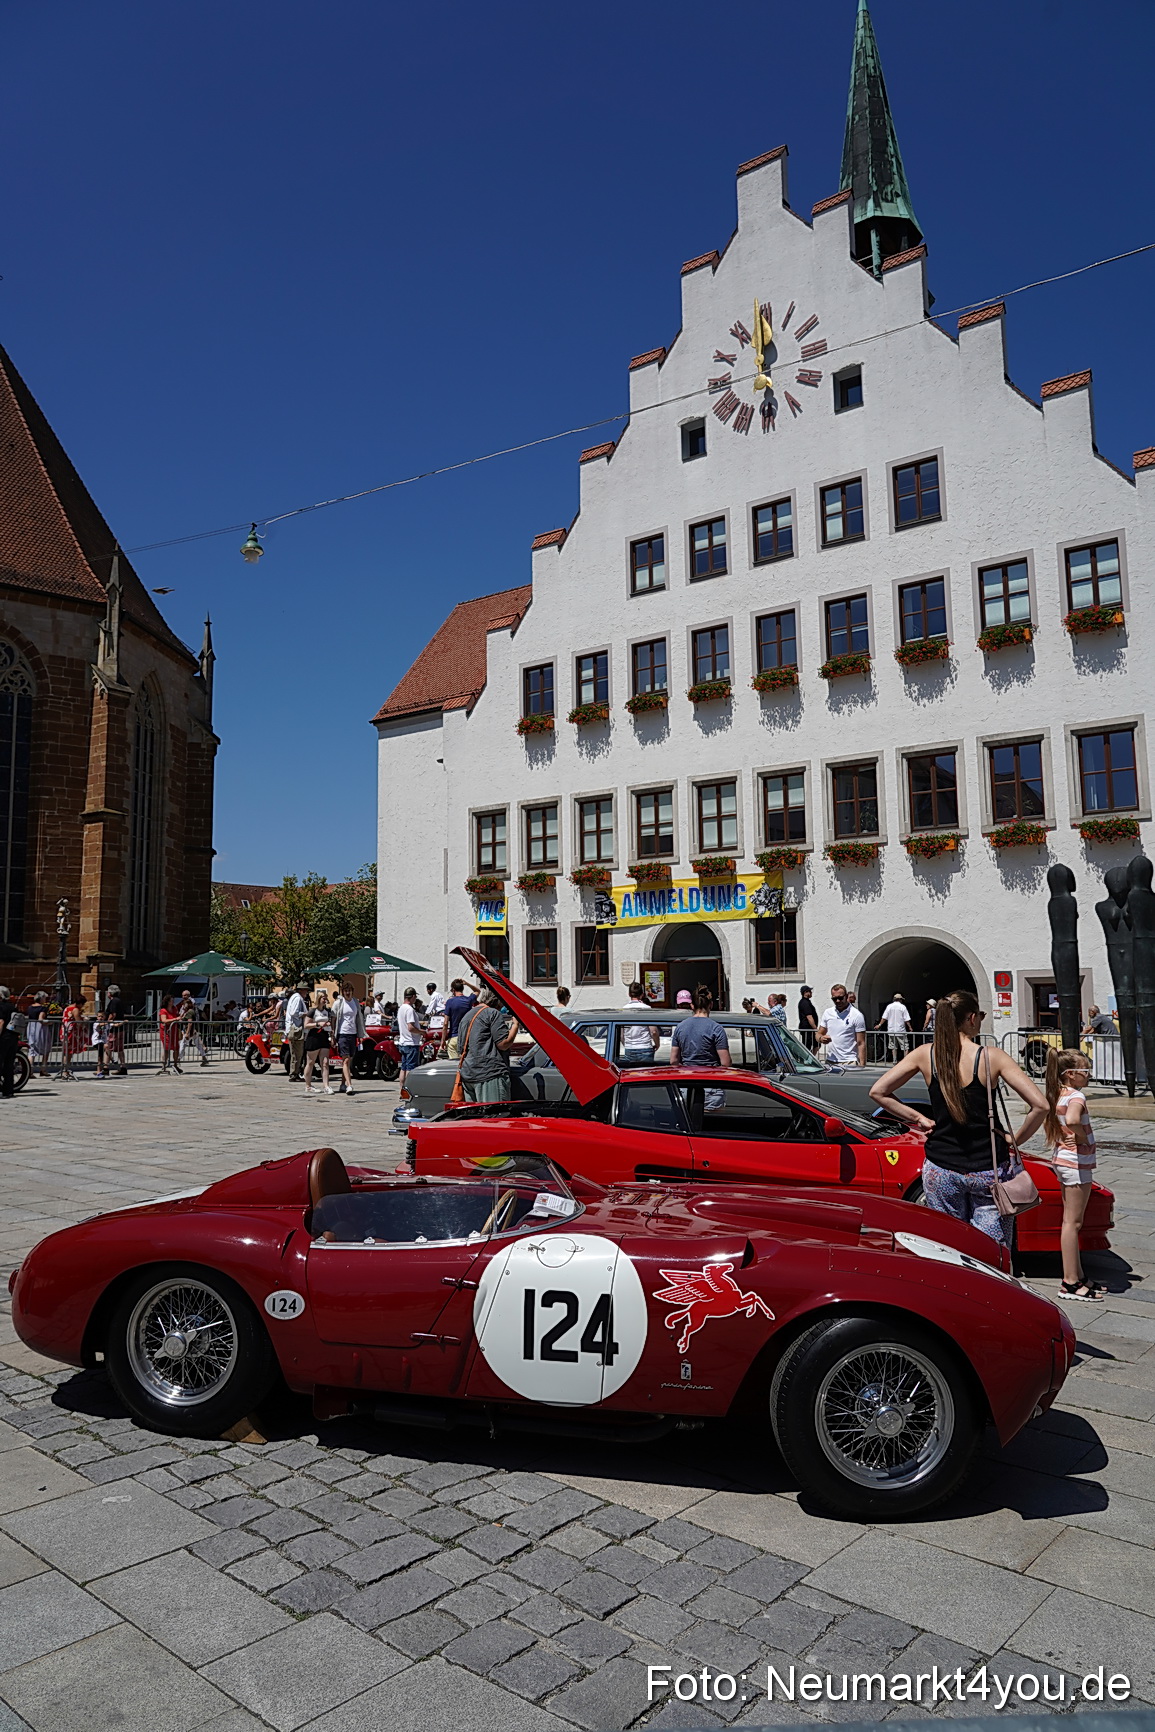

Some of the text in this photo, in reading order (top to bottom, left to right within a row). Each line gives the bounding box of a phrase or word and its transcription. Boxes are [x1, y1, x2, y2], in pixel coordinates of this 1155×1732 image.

[478, 899, 506, 922] WC
[619, 883, 748, 919] ANMELDUNG
[272, 1298, 297, 1313] 124
[522, 1287, 620, 1367] 124
